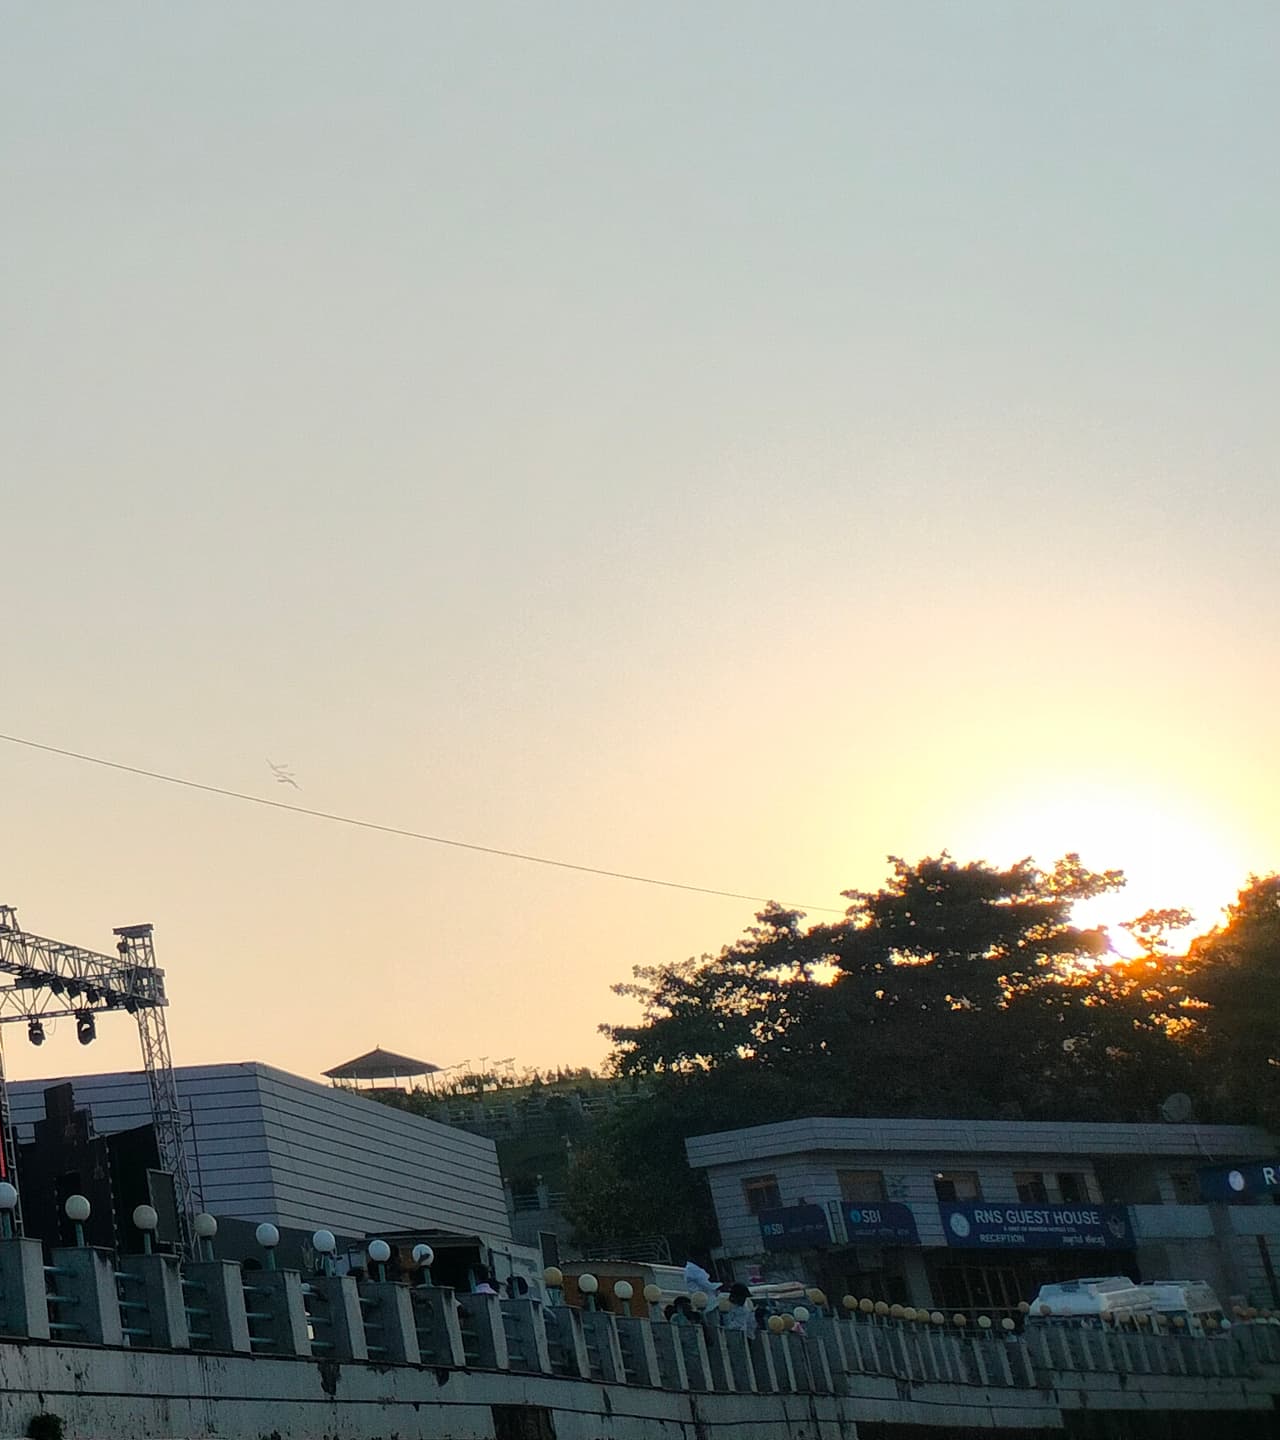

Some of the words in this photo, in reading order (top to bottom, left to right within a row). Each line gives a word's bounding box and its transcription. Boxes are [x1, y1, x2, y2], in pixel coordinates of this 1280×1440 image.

[1262, 1167, 1280, 1185] R
[863, 1209, 881, 1223] SBI
[974, 1210, 1003, 1224] RNS
[1006, 1210, 1049, 1225] GUEST
[1053, 1211, 1100, 1226] HOUSE
[979, 1234, 1025, 1243] RECEPTION
